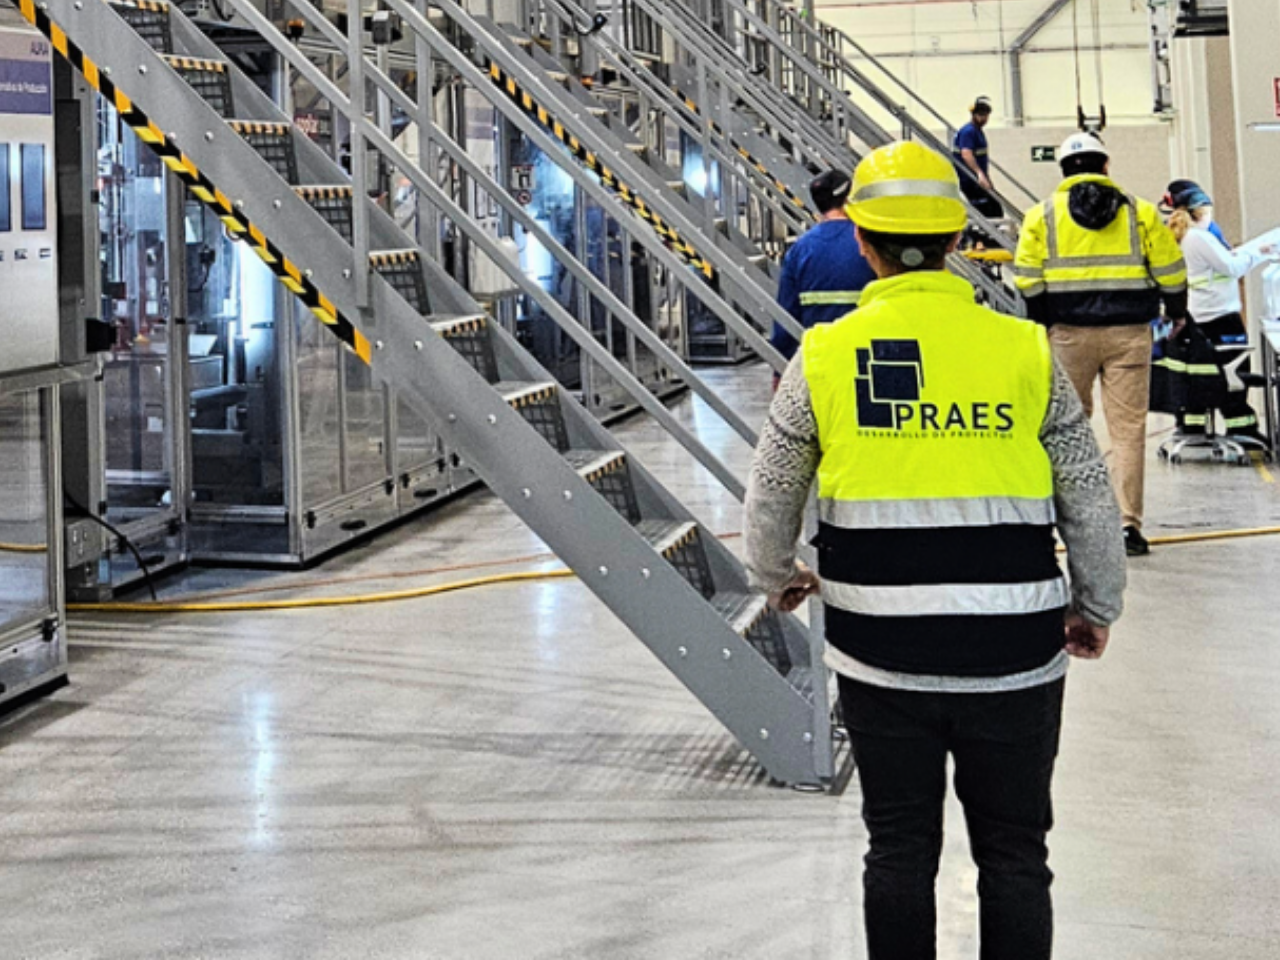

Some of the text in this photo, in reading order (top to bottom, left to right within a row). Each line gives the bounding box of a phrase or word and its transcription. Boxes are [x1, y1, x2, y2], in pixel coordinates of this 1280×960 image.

[895, 401, 1015, 432] PRAES
[856, 430, 1014, 440] DESARROLLO DE PROYECTOS
